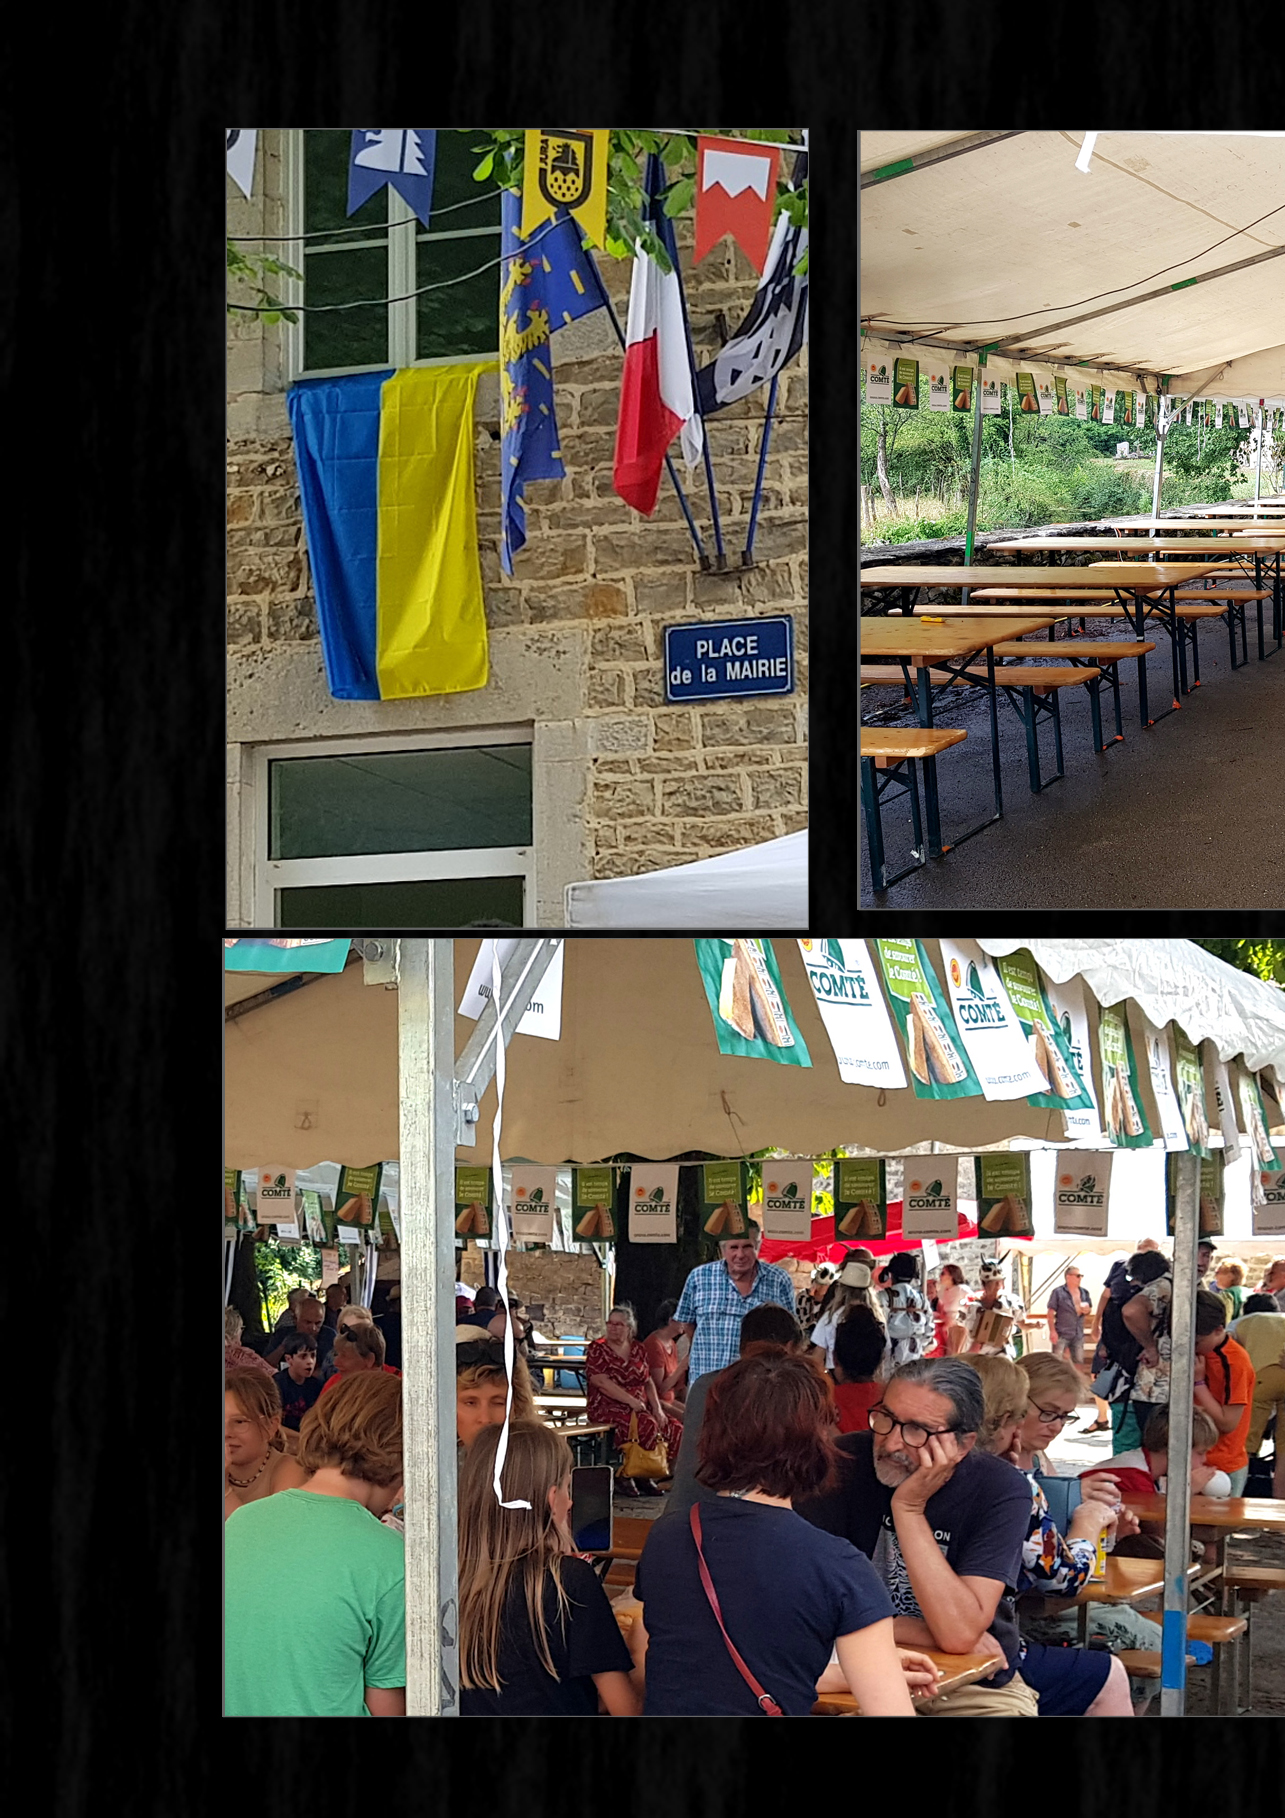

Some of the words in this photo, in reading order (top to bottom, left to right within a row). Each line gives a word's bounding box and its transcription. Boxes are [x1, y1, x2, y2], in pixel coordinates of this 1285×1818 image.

[540, 138, 549, 167] JURA
[696, 636, 758, 659] PLACE
[670, 666, 692, 685] de
[701, 664, 717, 682] la
[726, 657, 787, 681] MAIRIE
[810, 969, 870, 999] COMTÉ
[959, 1001, 1006, 1025] COMTÉ
